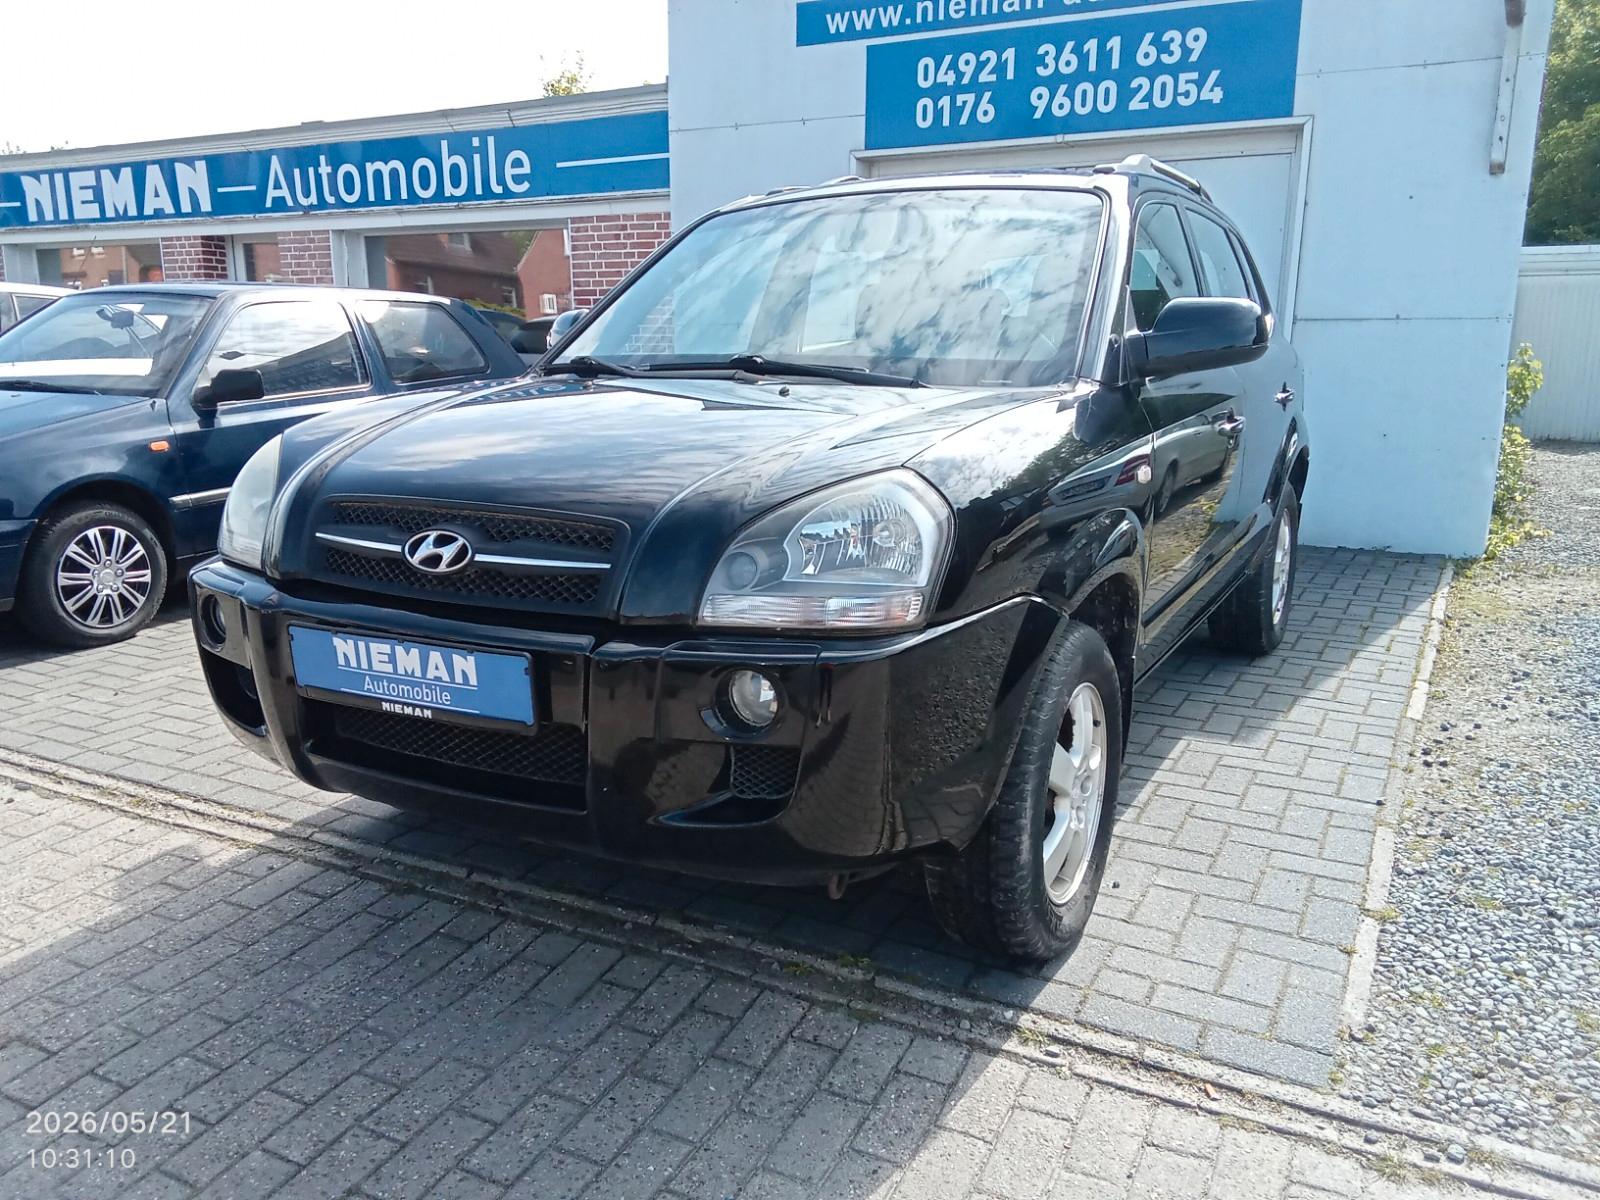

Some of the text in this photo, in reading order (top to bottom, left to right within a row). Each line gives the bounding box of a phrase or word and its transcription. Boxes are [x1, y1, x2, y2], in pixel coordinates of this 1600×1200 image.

[916, 27, 1208, 88] 04921 3611 639
[915, 69, 1224, 129] 0176 9600 2054
[20, 136, 532, 222] NIEMAN Automobile
[332, 636, 478, 686] NIEMAN
[363, 675, 452, 705] Automobile
[381, 701, 433, 719] NIEMAN
